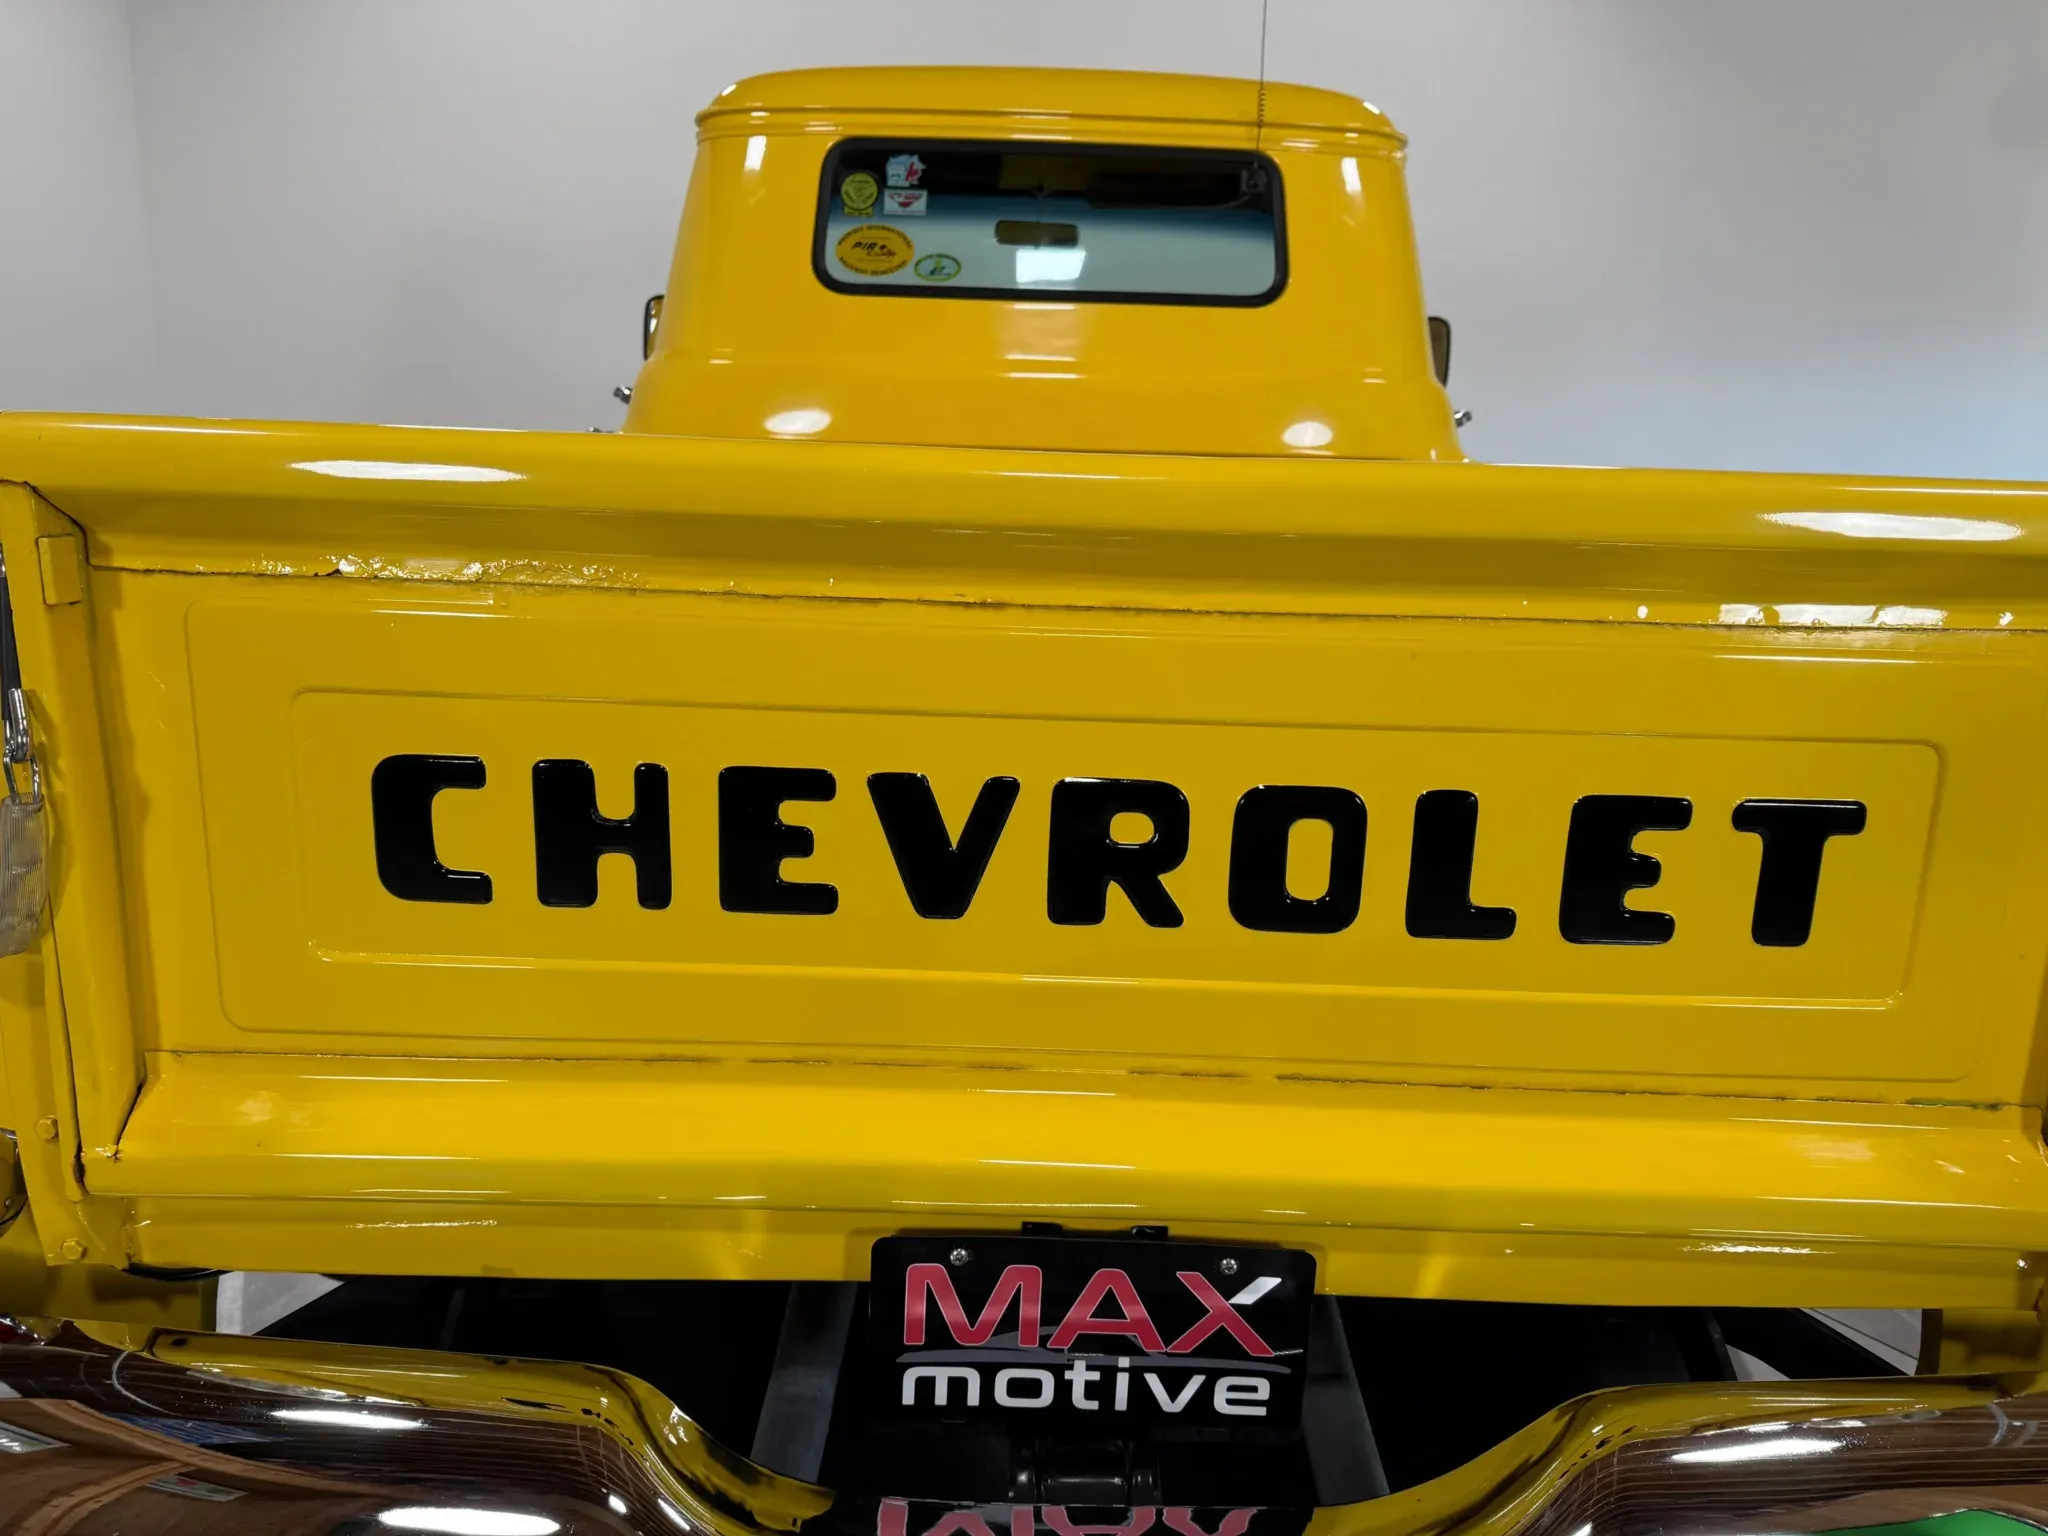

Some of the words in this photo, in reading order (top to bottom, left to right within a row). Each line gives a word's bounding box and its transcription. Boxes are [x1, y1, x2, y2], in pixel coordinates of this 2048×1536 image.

[371, 753, 1868, 947] CHEVROLET
[903, 1262, 1282, 1357] MAX
[902, 1357, 1271, 1417] motive
